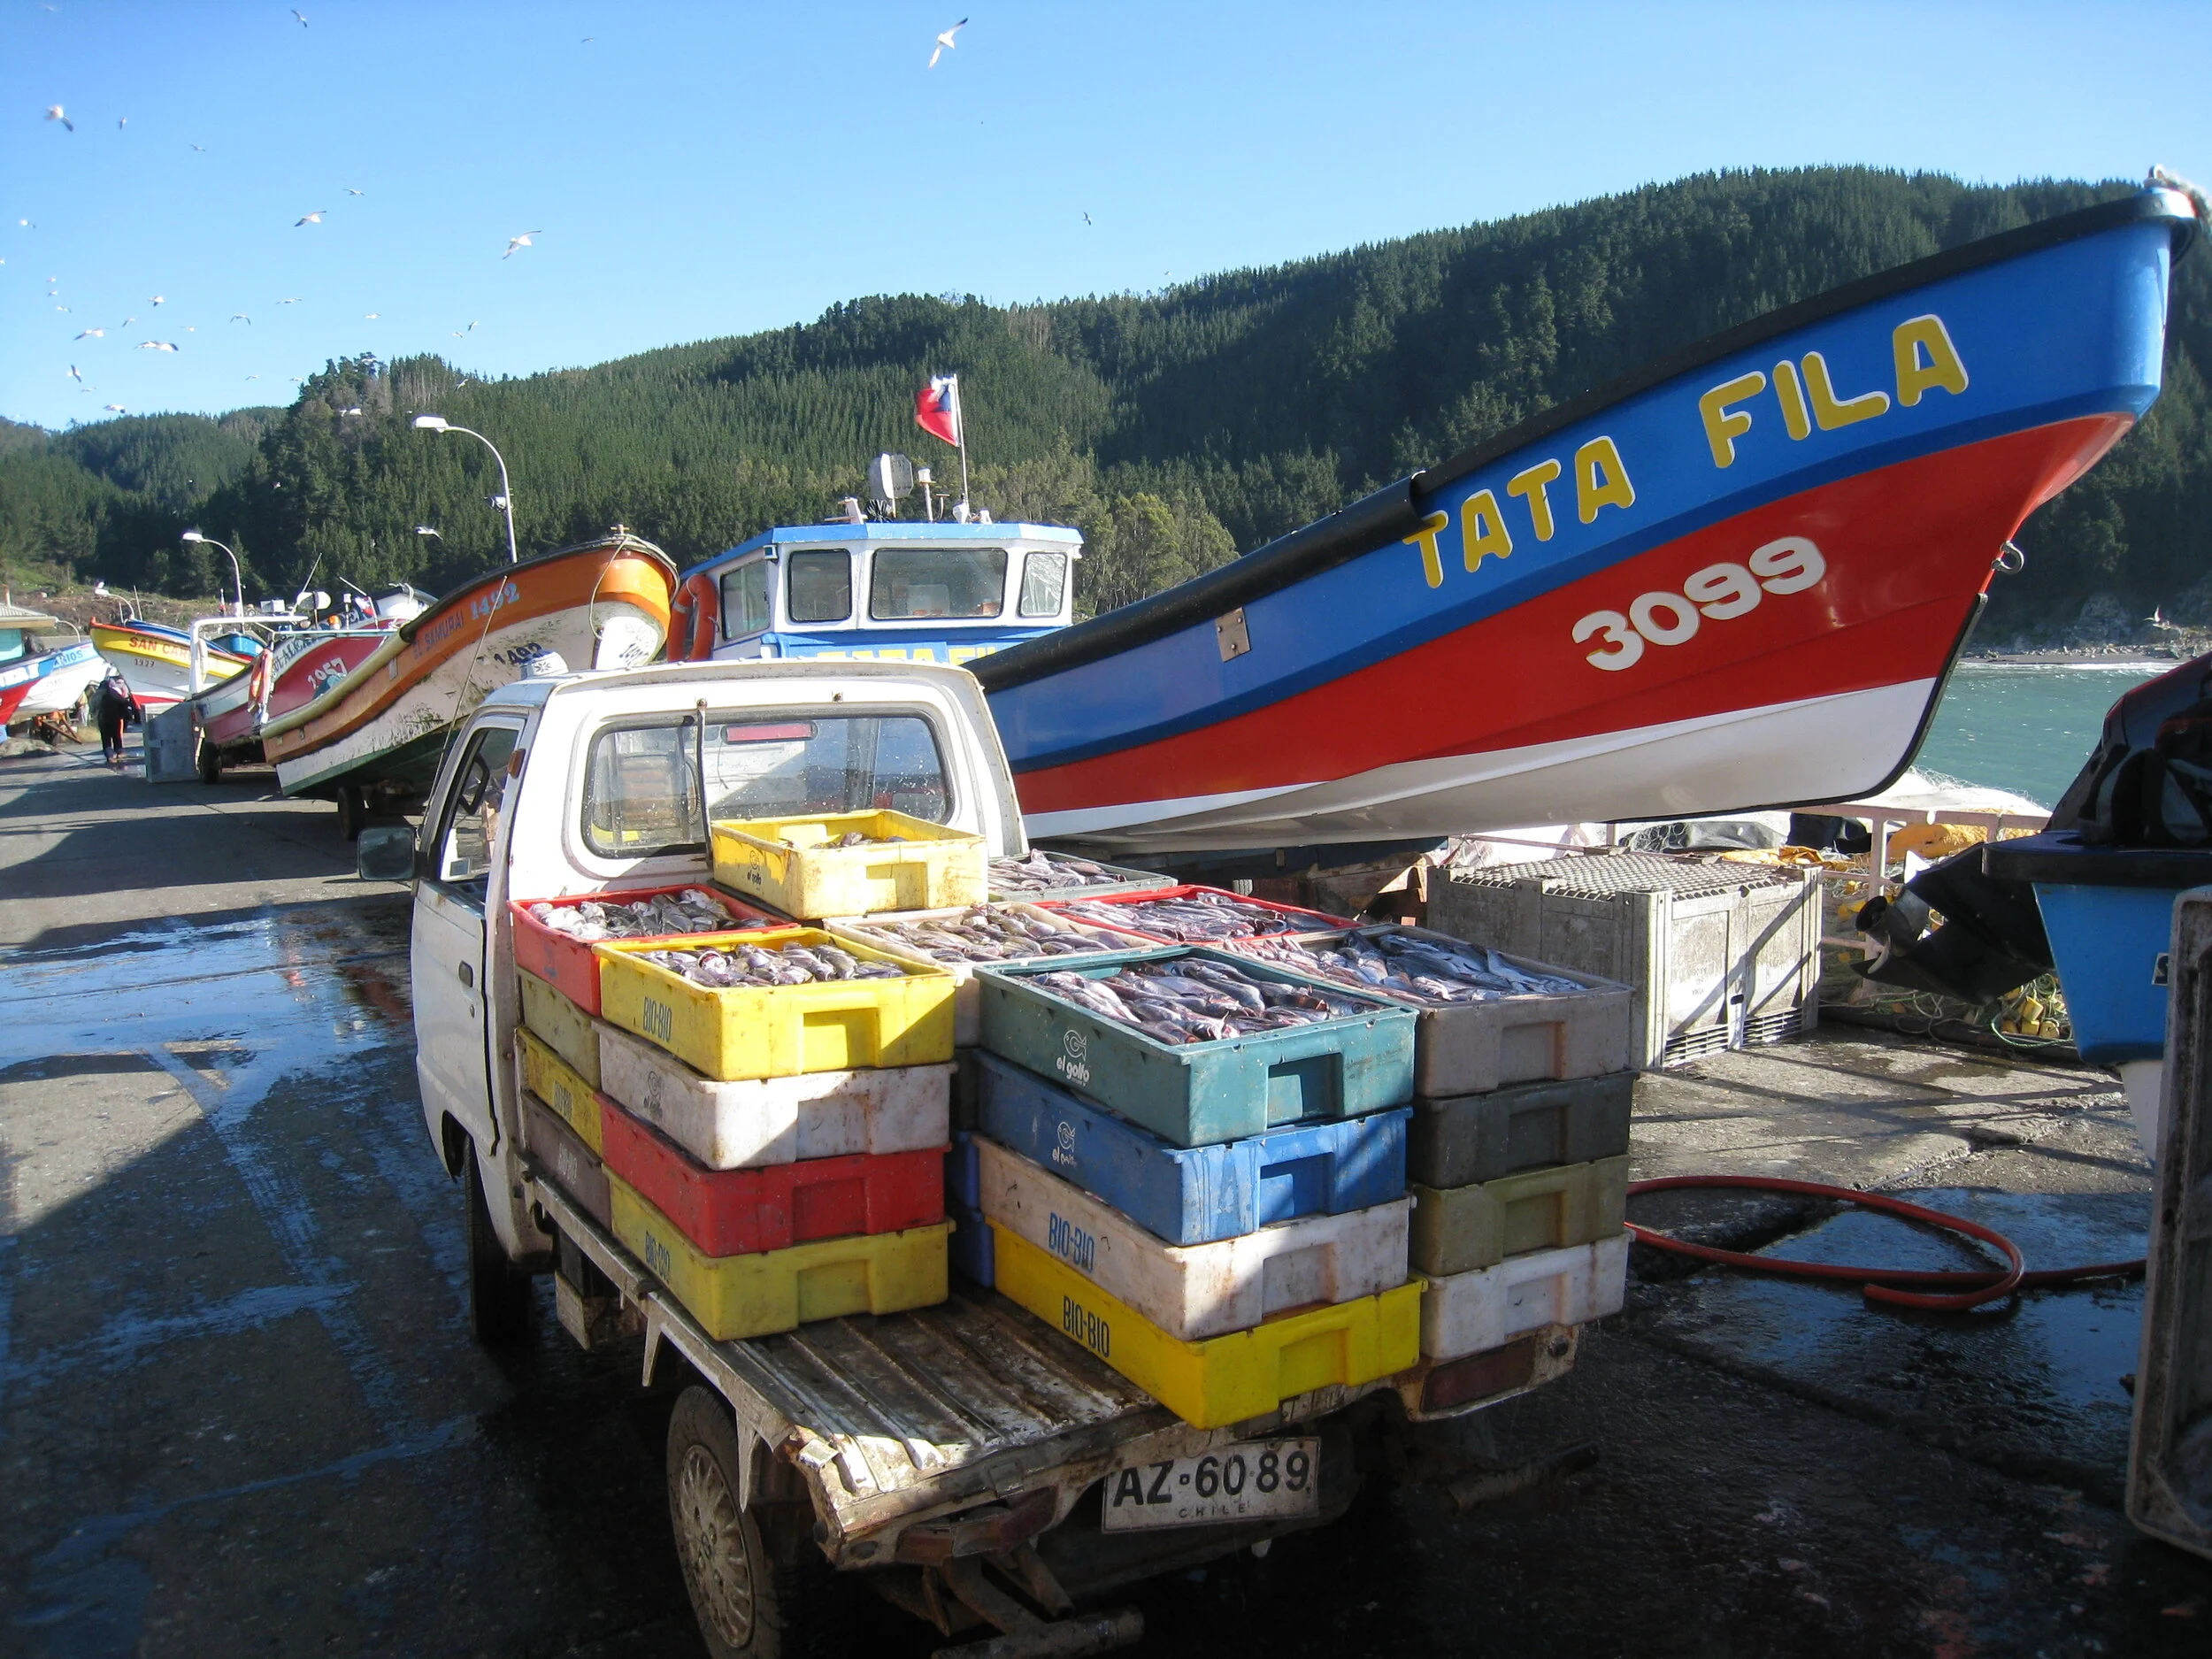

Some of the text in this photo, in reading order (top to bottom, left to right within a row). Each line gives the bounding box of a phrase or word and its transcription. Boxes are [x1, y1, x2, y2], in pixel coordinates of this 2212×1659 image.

[1402, 314, 1969, 588] TATA FILA
[471, 582, 520, 620] 1492
[1571, 536, 1827, 672] 3099
[129, 636, 157, 651] SAN
[643, 996, 672, 1043] BIO-BIO
[1056, 1055, 1065, 1071] el
[1066, 1062, 1090, 1083] golfo
[1048, 1212, 1095, 1274] BIO-BIO
[1063, 1295, 1110, 1358] BIO-BIO
[1179, 1502, 1246, 1518] CHILE
